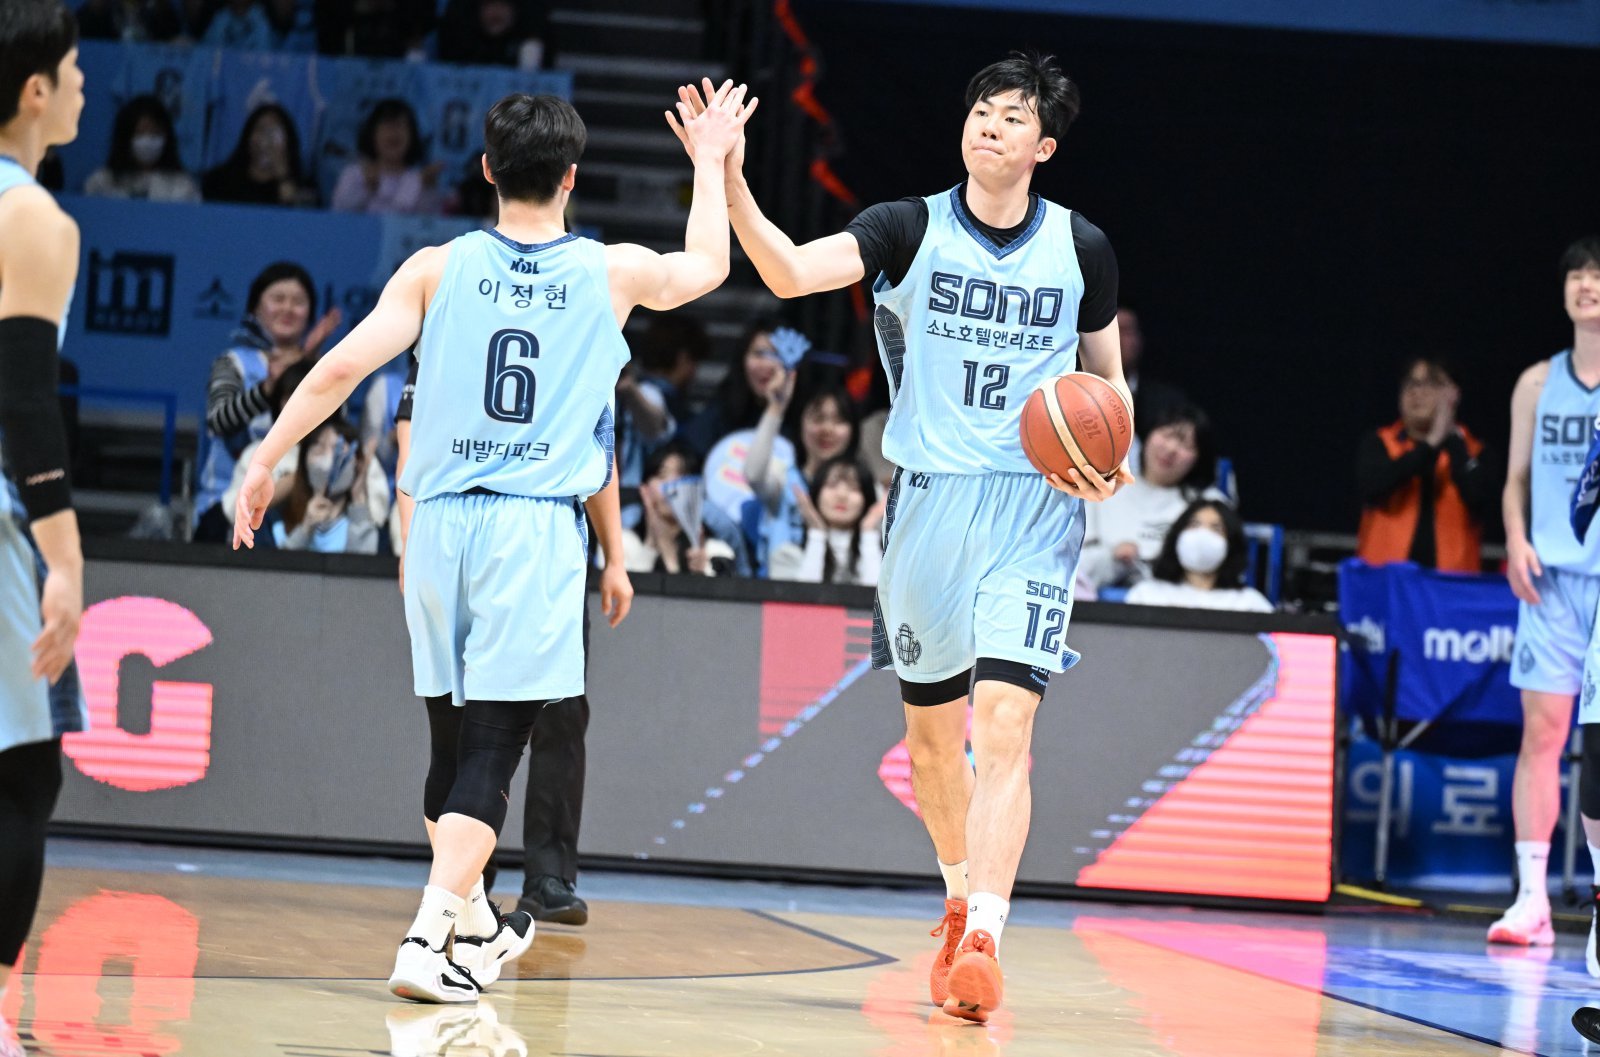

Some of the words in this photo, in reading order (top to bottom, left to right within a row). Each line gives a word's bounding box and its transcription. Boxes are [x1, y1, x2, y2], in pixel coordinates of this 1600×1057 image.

[478, 278, 567, 310] 이정현
[926, 319, 1055, 352] 소노호텔앤리조트
[484, 328, 540, 424] 6
[963, 360, 1010, 411] 12
[1024, 601, 1066, 655] 12
[62, 596, 213, 792] G
